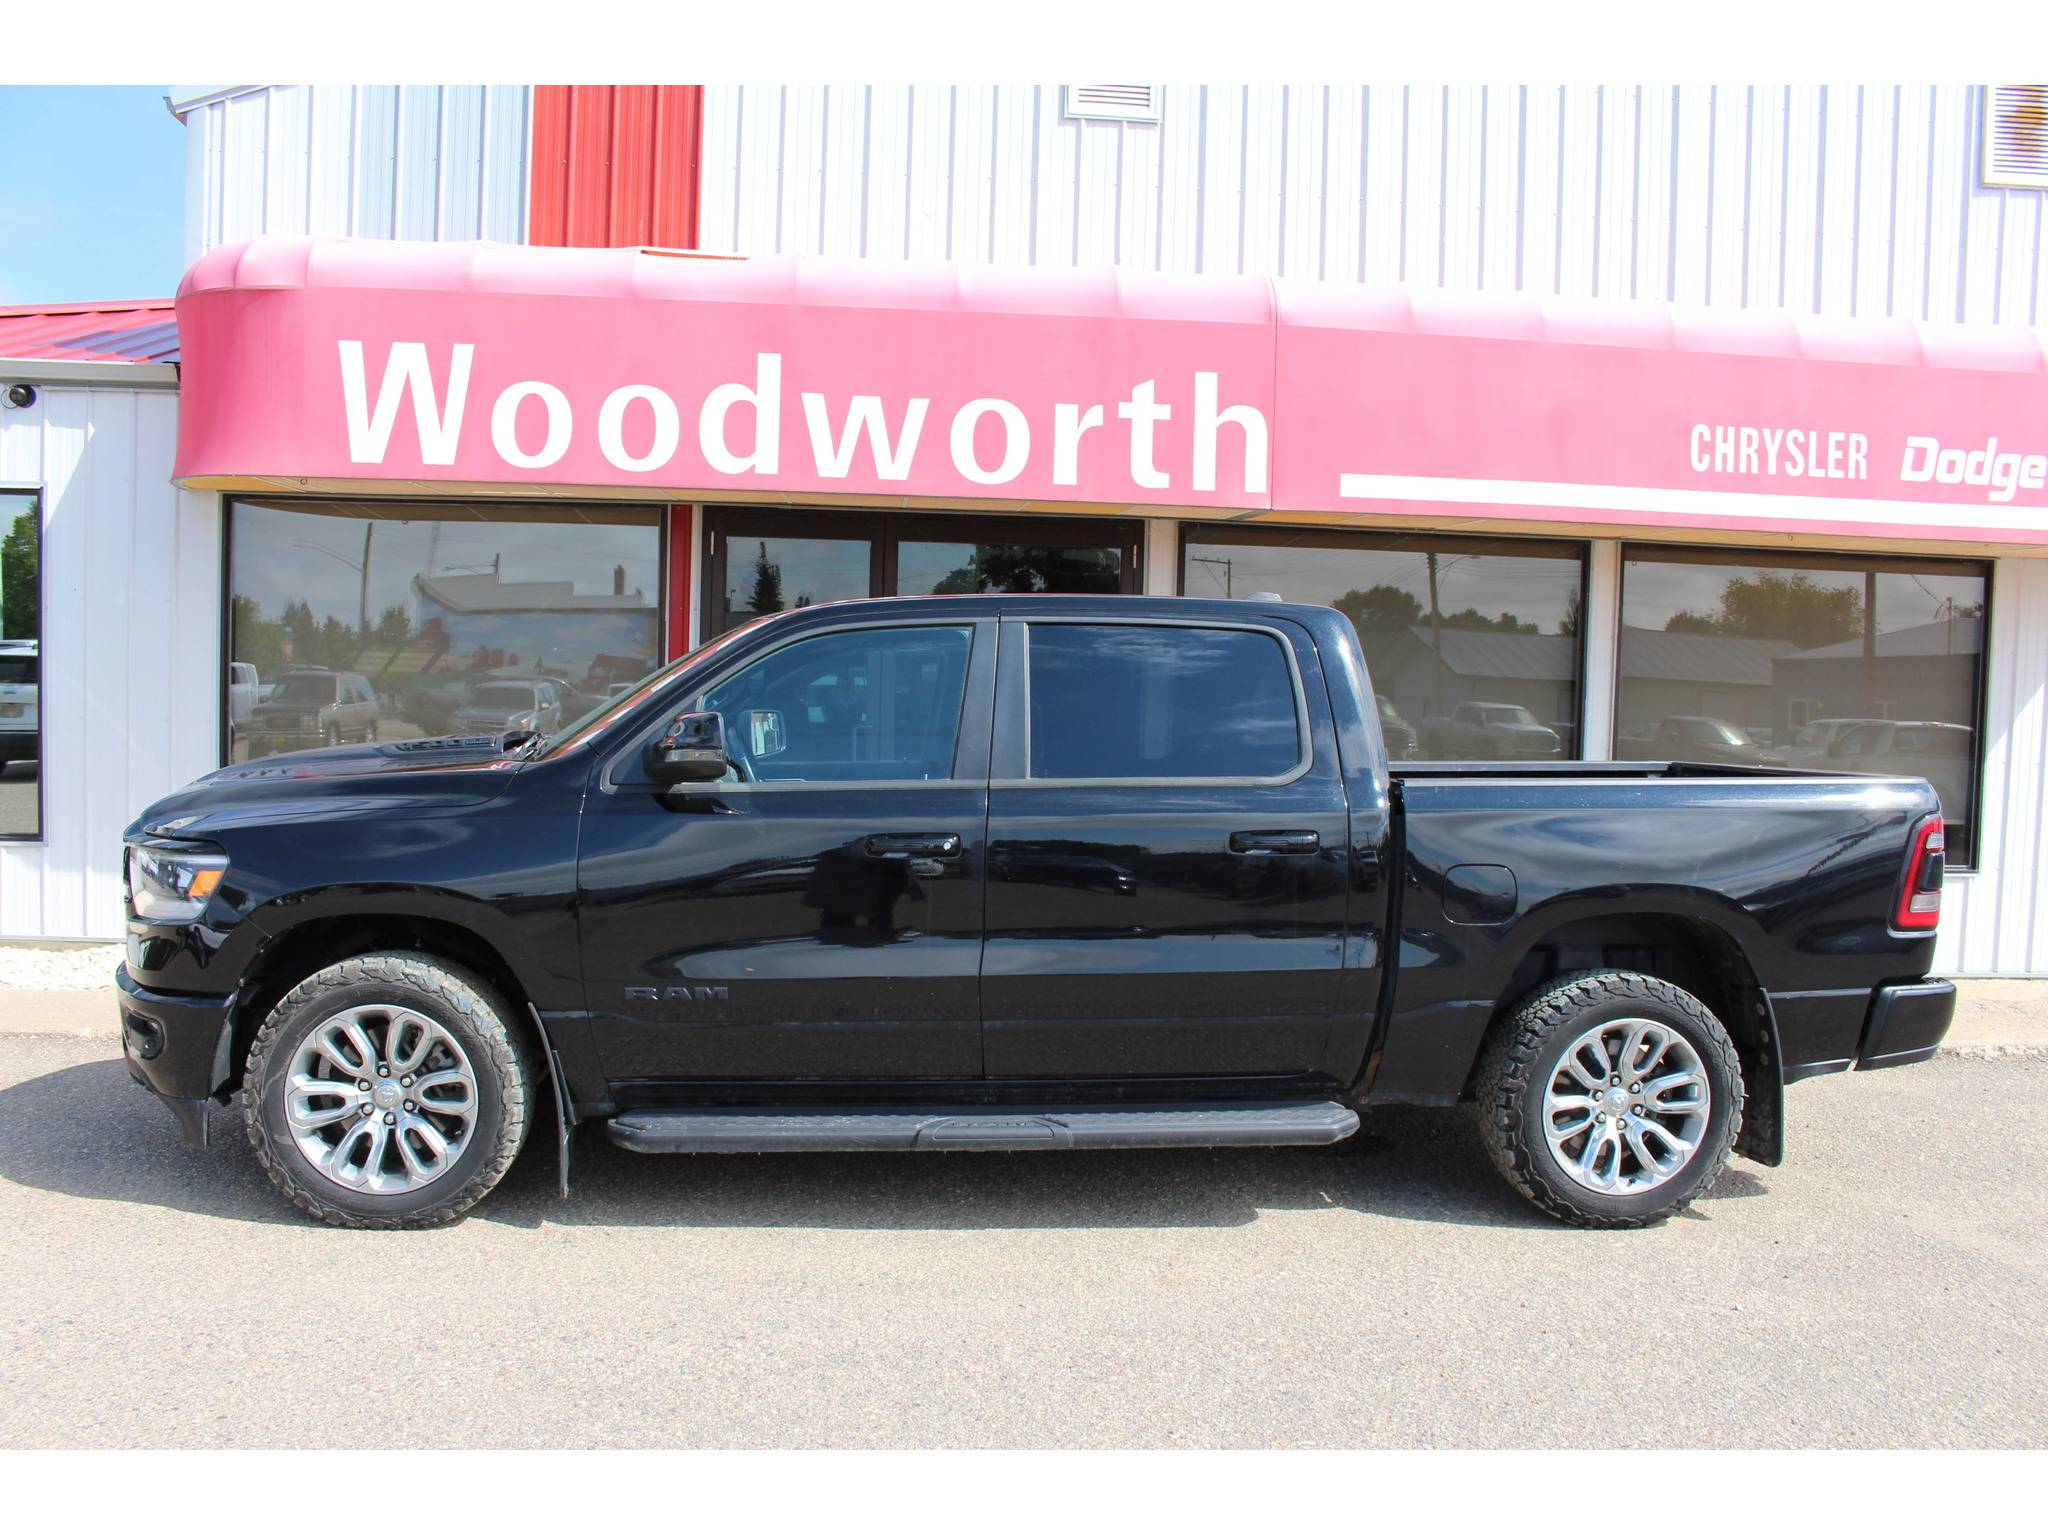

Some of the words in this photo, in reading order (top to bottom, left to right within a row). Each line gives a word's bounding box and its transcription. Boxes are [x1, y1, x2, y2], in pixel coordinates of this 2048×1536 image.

[337, 340, 1270, 493] Woodworth
[1690, 423, 1869, 480] CHRYSLER
[1900, 436, 2048, 502] Dodge
[623, 986, 729, 1001] RAM
